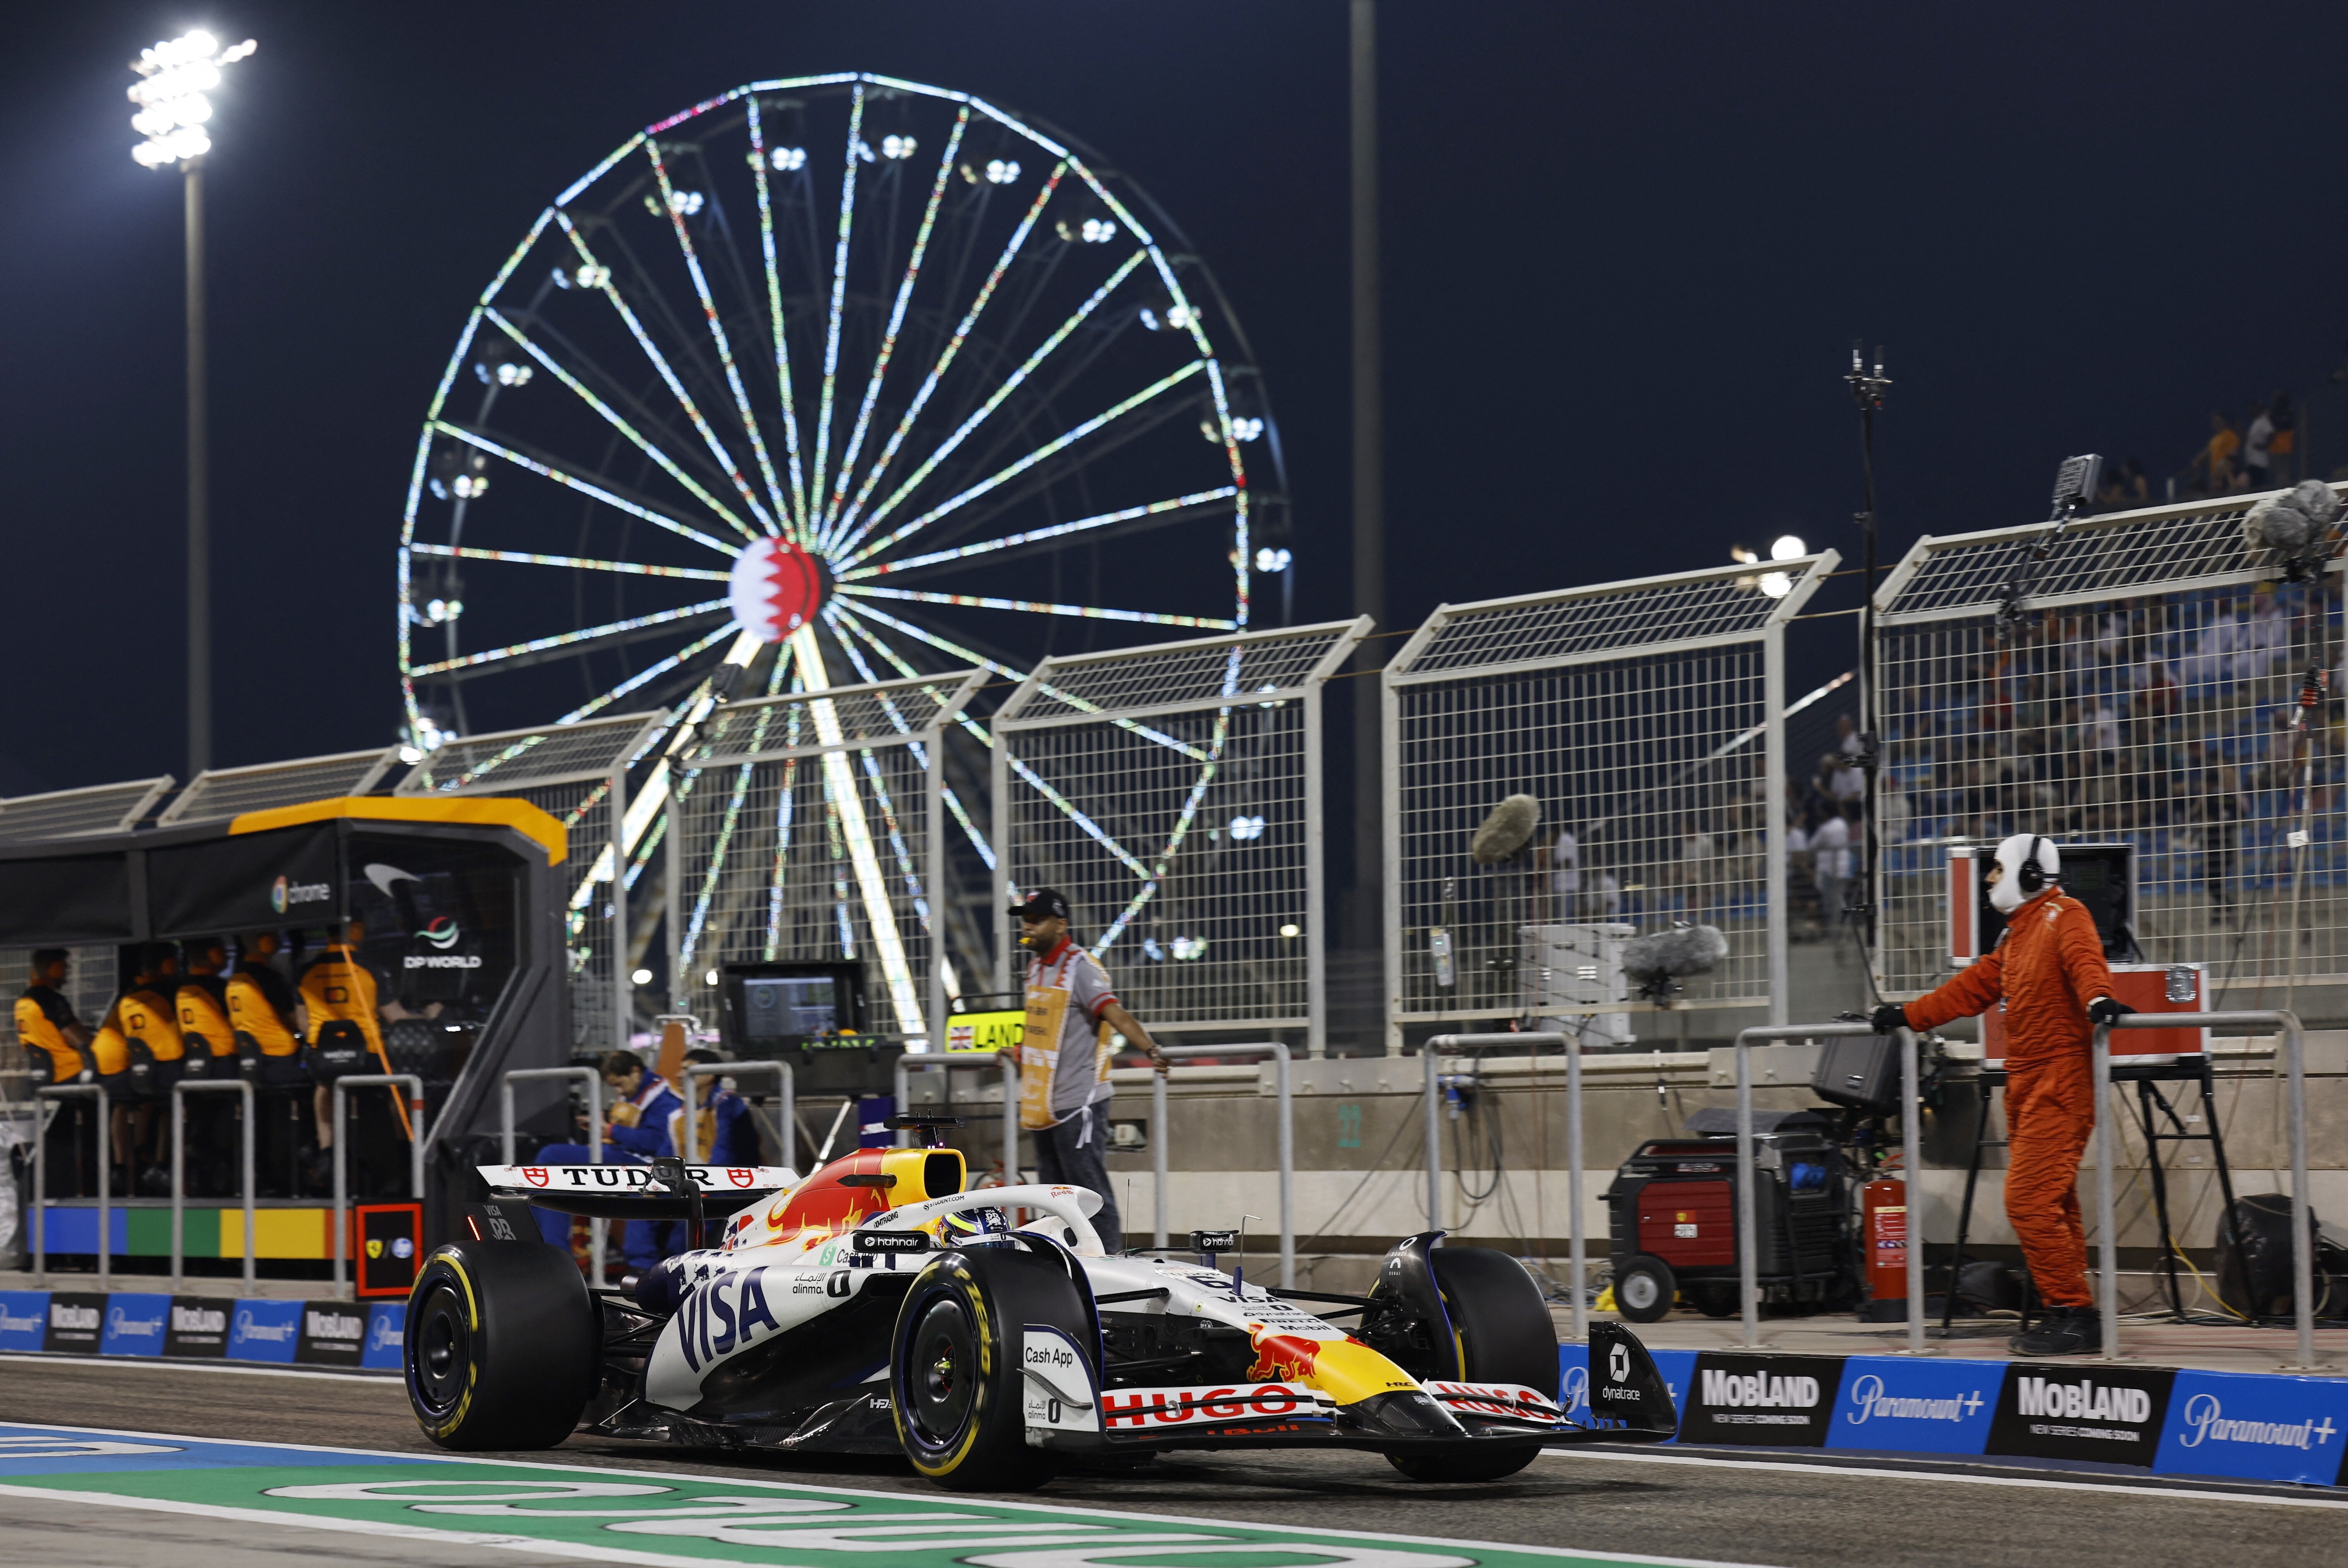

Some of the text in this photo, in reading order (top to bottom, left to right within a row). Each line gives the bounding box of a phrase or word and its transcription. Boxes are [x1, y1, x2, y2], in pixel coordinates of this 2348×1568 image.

[289, 881, 330, 904] chrome
[404, 956, 482, 968] DP WORLD
[563, 1168, 714, 1186] TUDR
[483, 1205, 502, 1216] VISA
[930, 1196, 964, 1207] STUDENT.COM
[878, 1237, 918, 1246] hahnair
[1186, 1276, 1234, 1288] 6
[677, 1266, 780, 1374] VISA
[1026, 1347, 1073, 1368] Cash App
[1436, 1384, 1555, 1420] HUGO
[1603, 1385, 1640, 1401] dynatrace
[1846, 1375, 1985, 1424] Paramount+
[1028, 1410, 1046, 1420] alinma
[1102, 1385, 1296, 1427] HUGO
[2179, 1393, 2337, 1450] Paramount+
